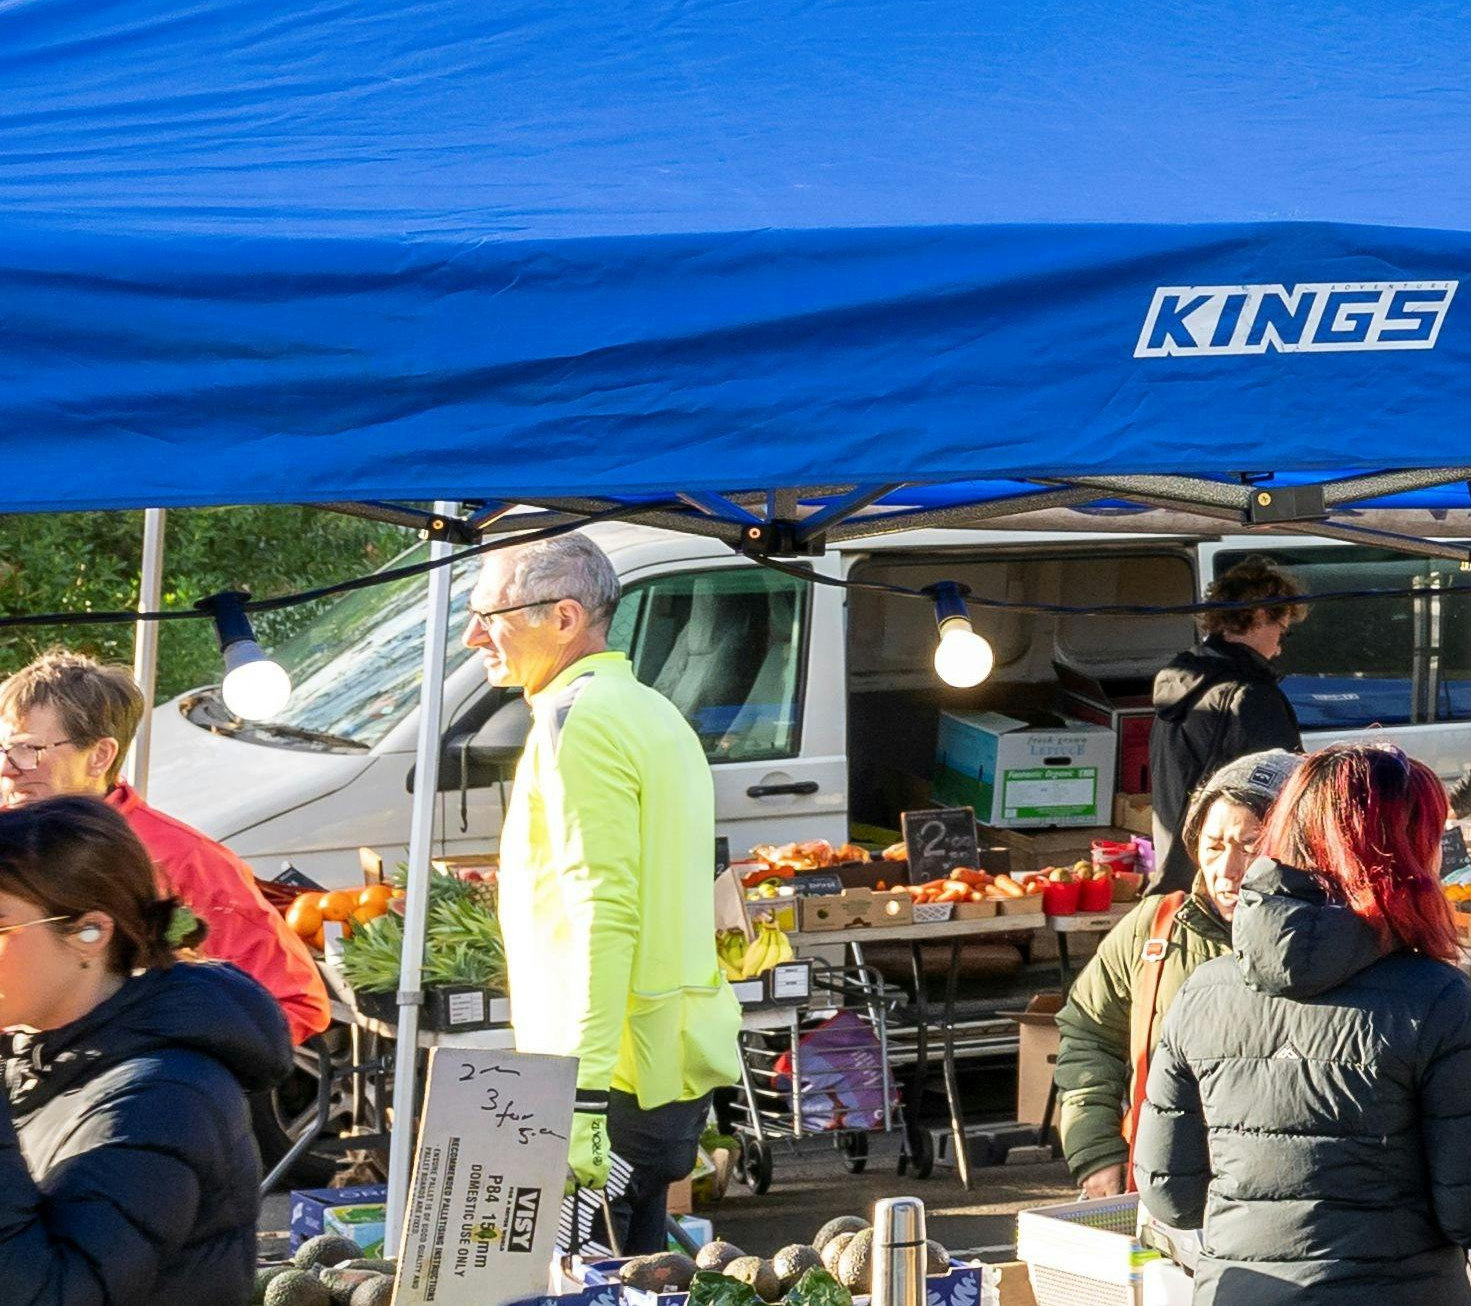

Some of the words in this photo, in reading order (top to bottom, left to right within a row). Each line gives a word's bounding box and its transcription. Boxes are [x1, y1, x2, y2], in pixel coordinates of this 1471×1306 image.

[1330, 282, 1452, 292] ADVENTURE
[1136, 283, 1457, 357] KINGS
[481, 1088, 498, 1110] 3
[444, 1137, 460, 1196] RECOMMENDED
[487, 1175, 503, 1203] P84
[465, 1165, 482, 1222] DOMESTIC
[435, 1198, 451, 1246] PALLETISING
[460, 1223, 474, 1245] USE
[508, 1187, 541, 1252] VISY
[426, 1247, 443, 1301] INSTRUCTIONS
[454, 1248, 470, 1278] ONLY
